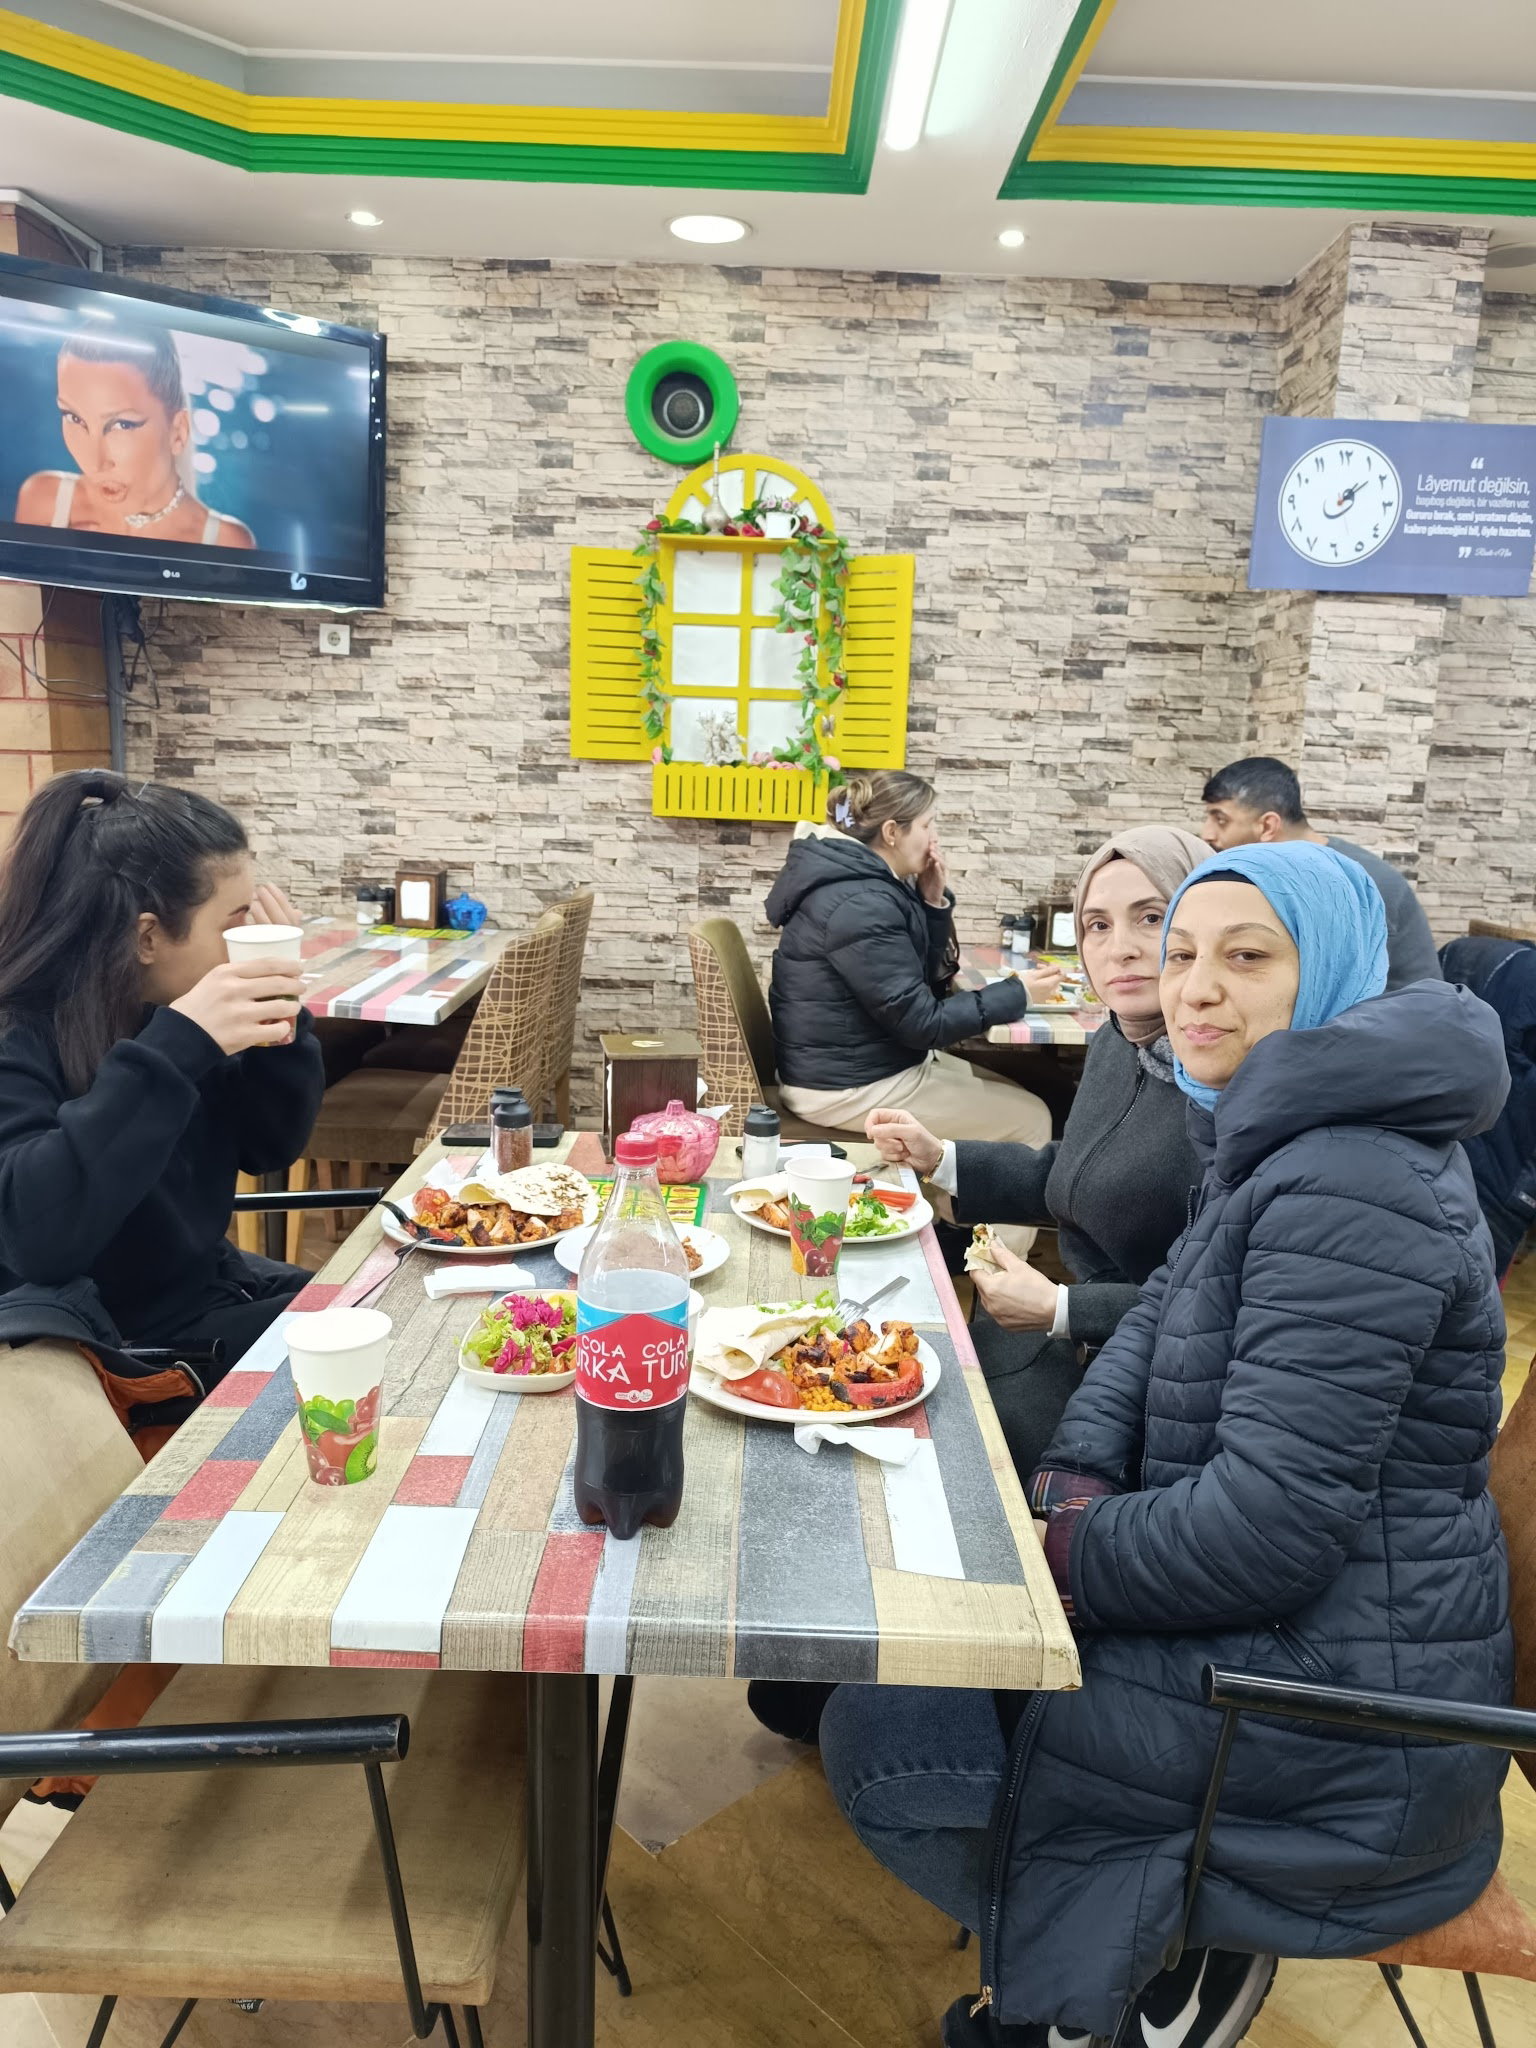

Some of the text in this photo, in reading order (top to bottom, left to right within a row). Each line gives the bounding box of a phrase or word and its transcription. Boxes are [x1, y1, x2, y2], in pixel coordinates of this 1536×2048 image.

[1417, 474, 1531, 497] Lâyemut değilsin,
[581, 1335, 626, 1359] COLA
[641, 1333, 685, 1359] COLA
